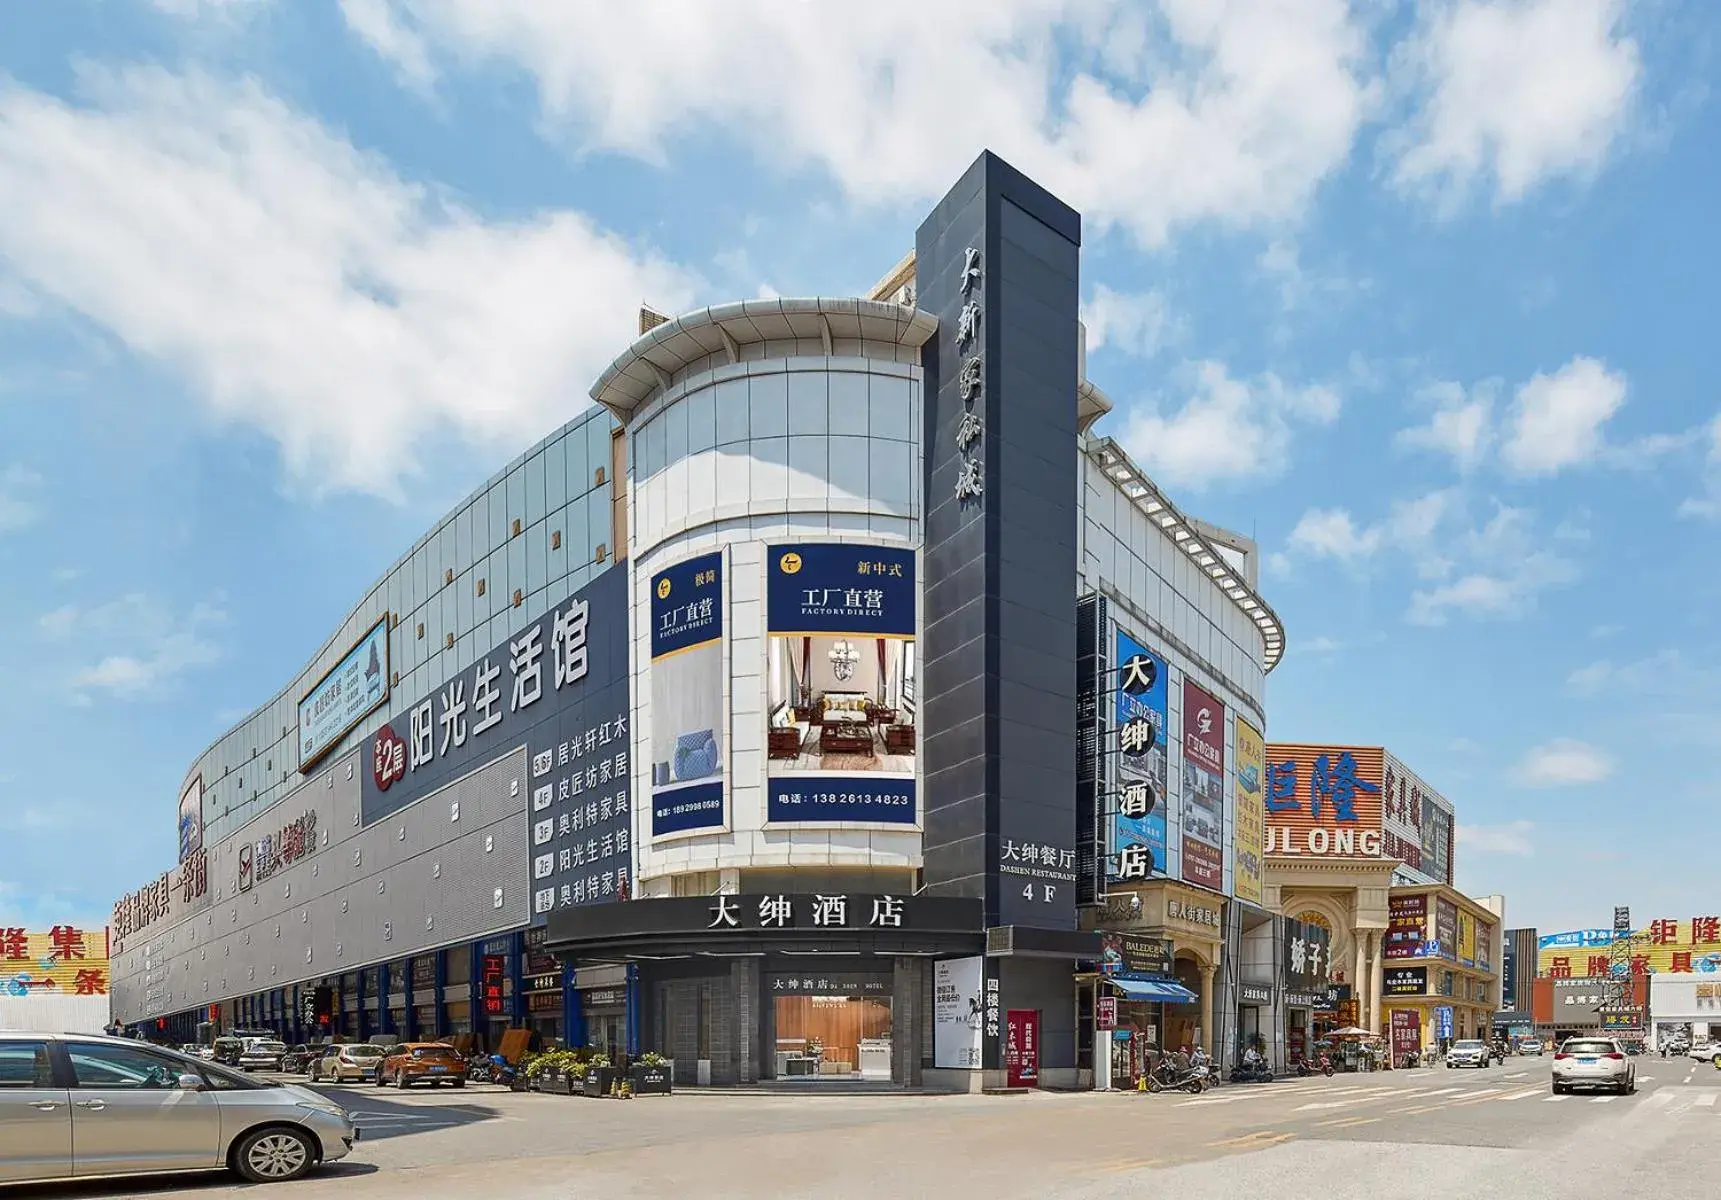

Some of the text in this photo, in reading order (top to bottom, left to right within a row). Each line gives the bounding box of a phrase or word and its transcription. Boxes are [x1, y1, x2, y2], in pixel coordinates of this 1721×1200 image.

[857, 561, 903, 577] 新中式
[801, 608, 884, 617] FACTORY DIRECT
[802, 588, 884, 608] 工厂直营
[660, 598, 712, 631] 工厂直营
[660, 617, 713, 638] FACTORY DIRECT
[409, 599, 590, 772] 阳光生活馆
[557, 714, 627, 766] 居光轩红木
[558, 752, 628, 801] 皮匠坊家居
[1119, 655, 1152, 878] 大绅酒店
[538, 791, 548, 802] 4F
[559, 790, 628, 837] 奥利特家具
[538, 825, 549, 837] 3F
[559, 828, 629, 872] 阳光生活馆
[1001, 840, 1076, 869] 大绅餐厅
[538, 860, 549, 874] 2F
[708, 894, 904, 929] 大绅酒店
[773, 979, 829, 990] 大绅酒店
[987, 978, 999, 1037] 四楼餐饮
